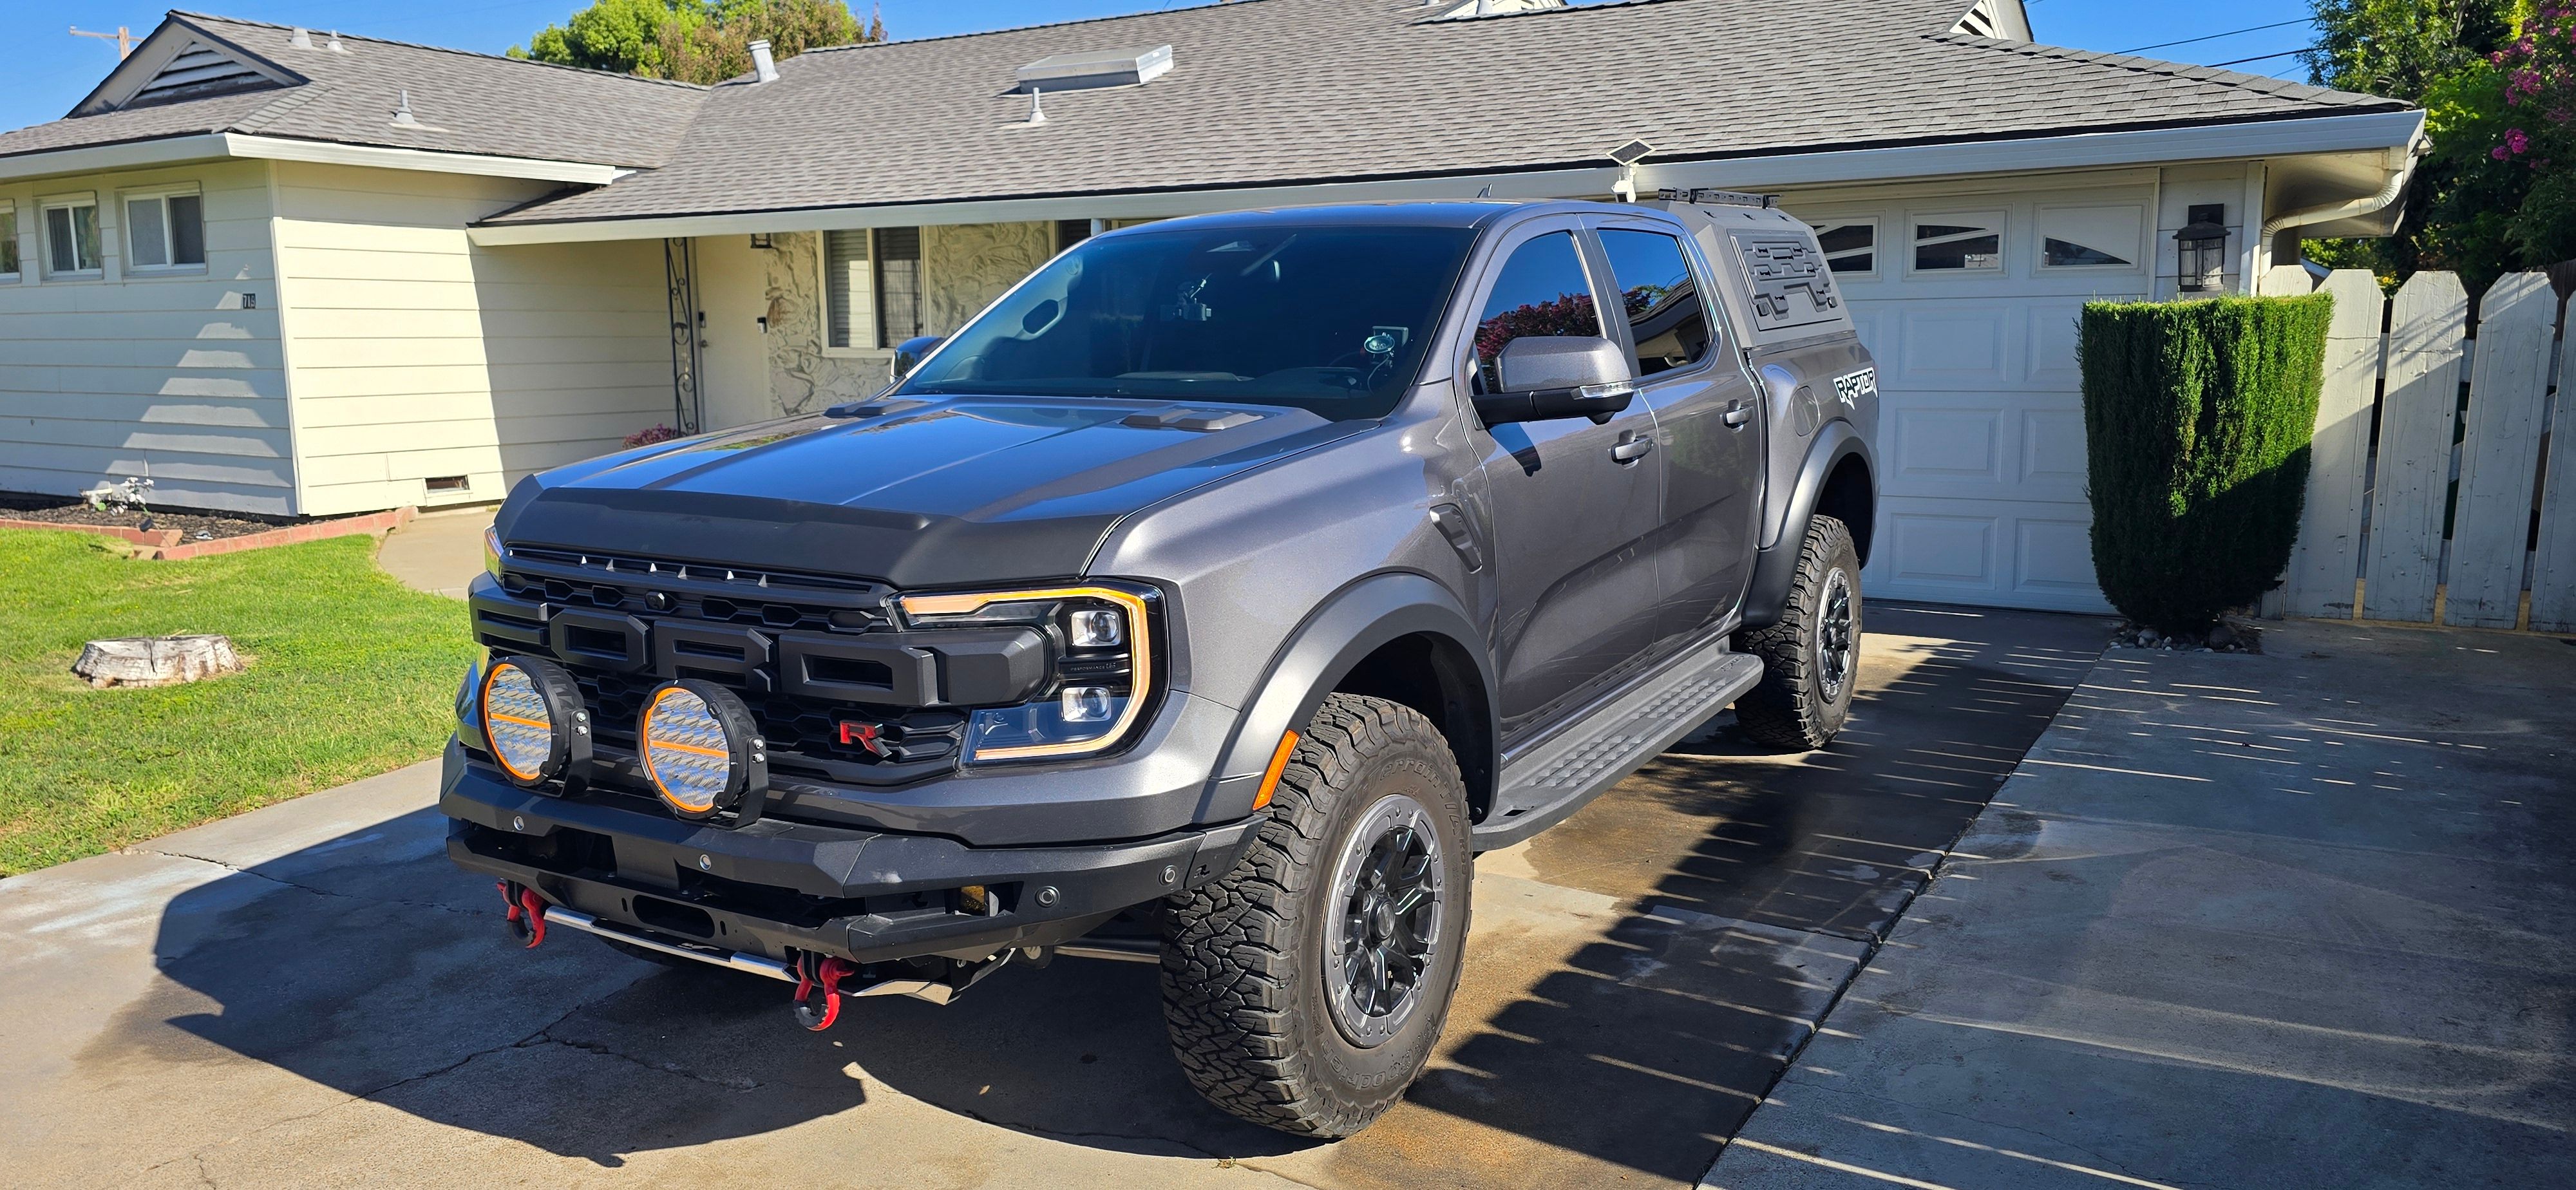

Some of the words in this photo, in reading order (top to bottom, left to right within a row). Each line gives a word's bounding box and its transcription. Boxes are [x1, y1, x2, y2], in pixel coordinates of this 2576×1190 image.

[1833, 367, 1878, 410] RAPTOR
[469, 586, 938, 706] FORD
[840, 720, 892, 758] R
